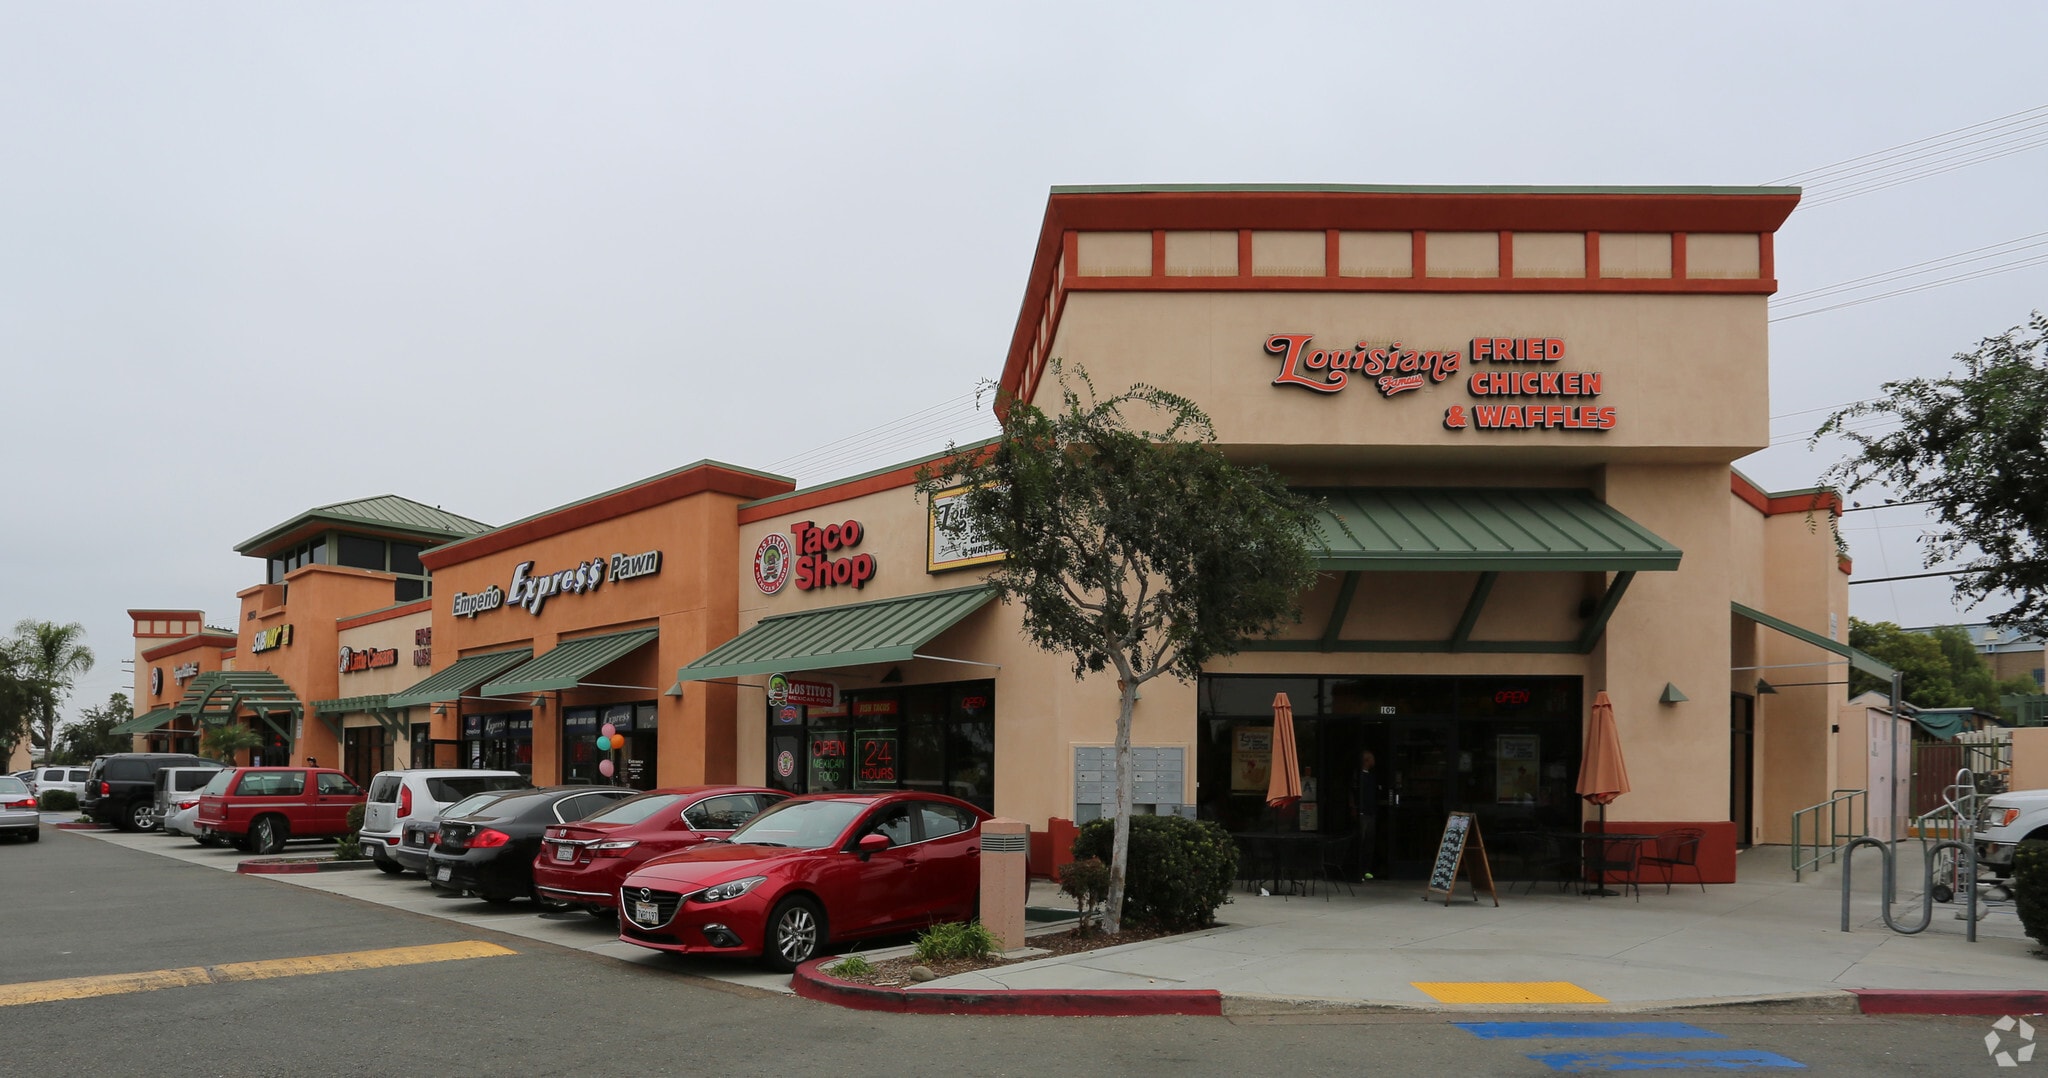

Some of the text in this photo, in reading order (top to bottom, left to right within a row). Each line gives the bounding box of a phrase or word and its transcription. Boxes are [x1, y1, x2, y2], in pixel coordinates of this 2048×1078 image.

[1471, 337, 1566, 361] FRIED
[1265, 334, 1462, 393] Louisiana
[1378, 373, 1425, 397] Famous
[1470, 371, 1604, 395] CHICKEN
[1445, 405, 1618, 429] & WAFFLES
[791, 519, 860, 556] Taco
[756, 541, 767, 563] LOS
[795, 552, 873, 590] Shop
[452, 585, 501, 618] Empeño
[608, 550, 660, 582] Pawn
[252, 626, 282, 652] SUBWAY
[788, 683, 833, 697] LOS TITO'S
[1494, 690, 1531, 704] OPEN
[780, 709, 797, 718] OPEN
[962, 696, 987, 709] OPEN
[1381, 706, 1395, 714] 109
[813, 740, 846, 756] OPEN
[865, 741, 892, 766] 24
[812, 758, 845, 769] MEXICAN
[861, 767, 894, 780] HOURS
[818, 770, 839, 782] FOOD
